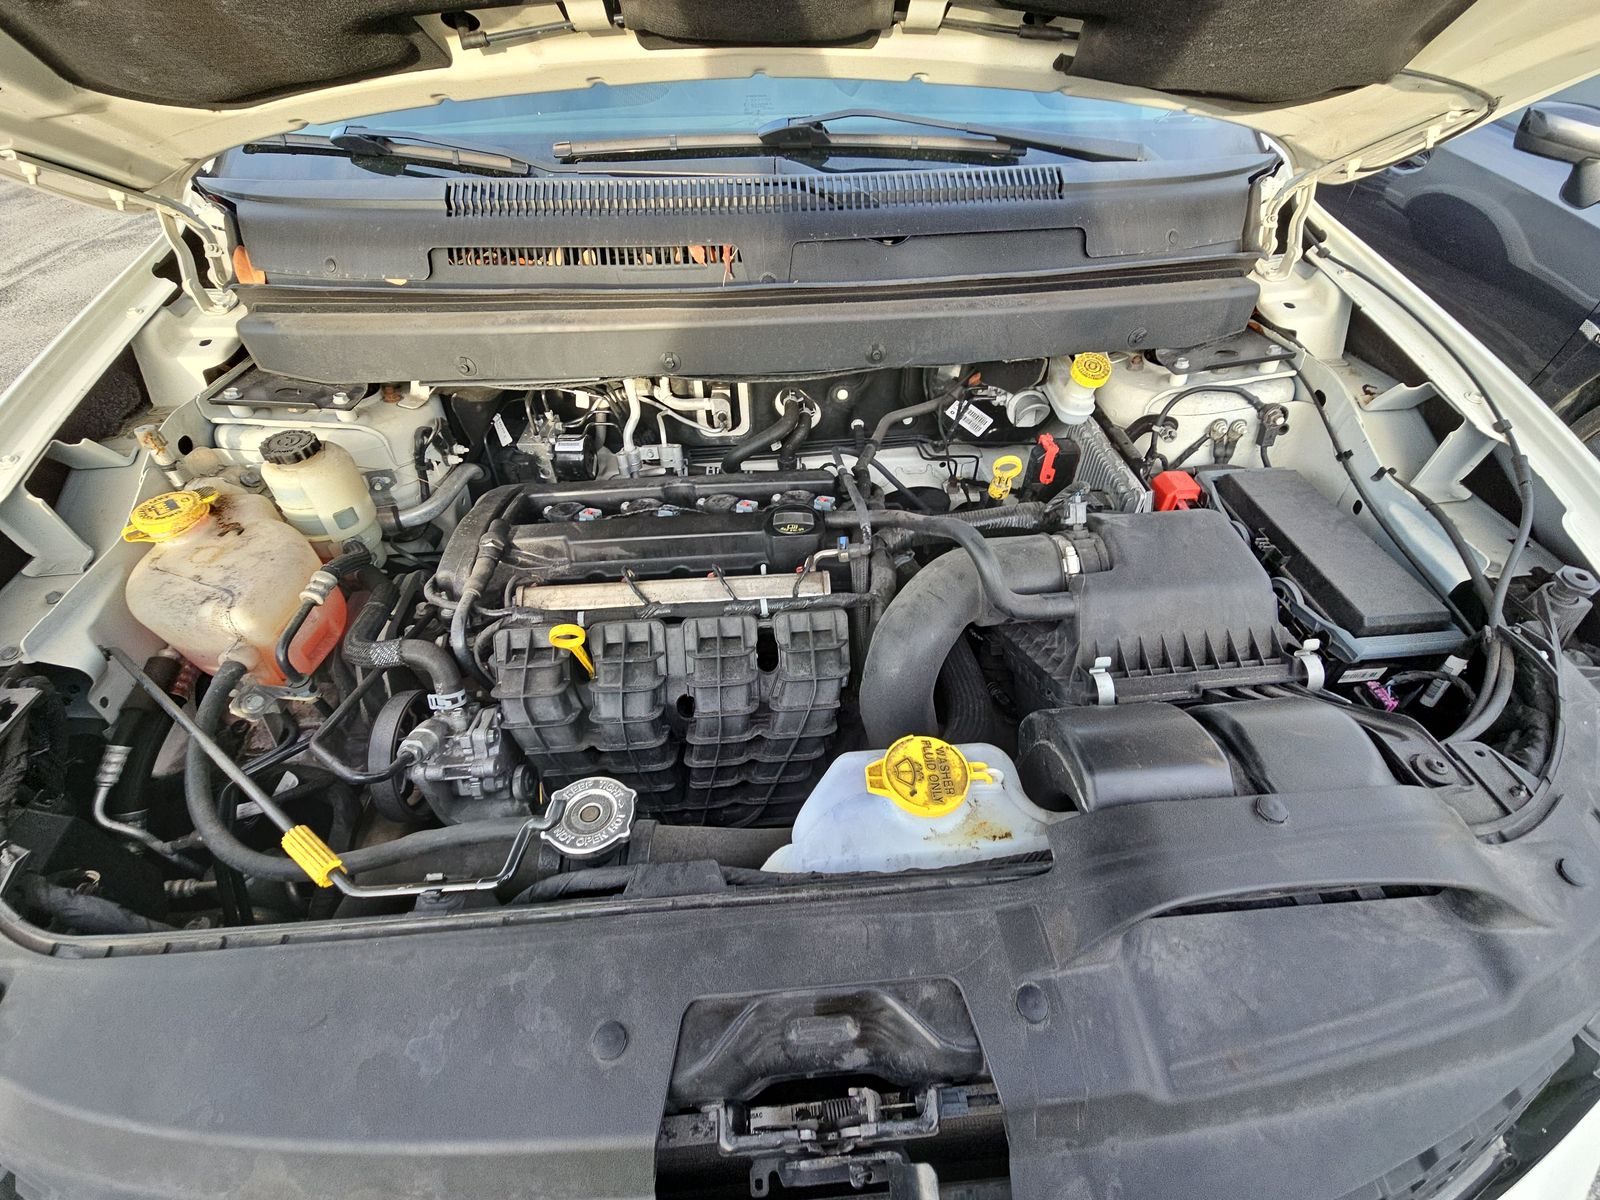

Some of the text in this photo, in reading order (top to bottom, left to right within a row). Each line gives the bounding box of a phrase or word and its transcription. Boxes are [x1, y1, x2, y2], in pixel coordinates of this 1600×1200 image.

[920, 739, 945, 804] FLUID ONLY
[935, 746, 956, 796] WASHER
[562, 781, 594, 800] KEEP
[553, 827, 576, 845] NOT
